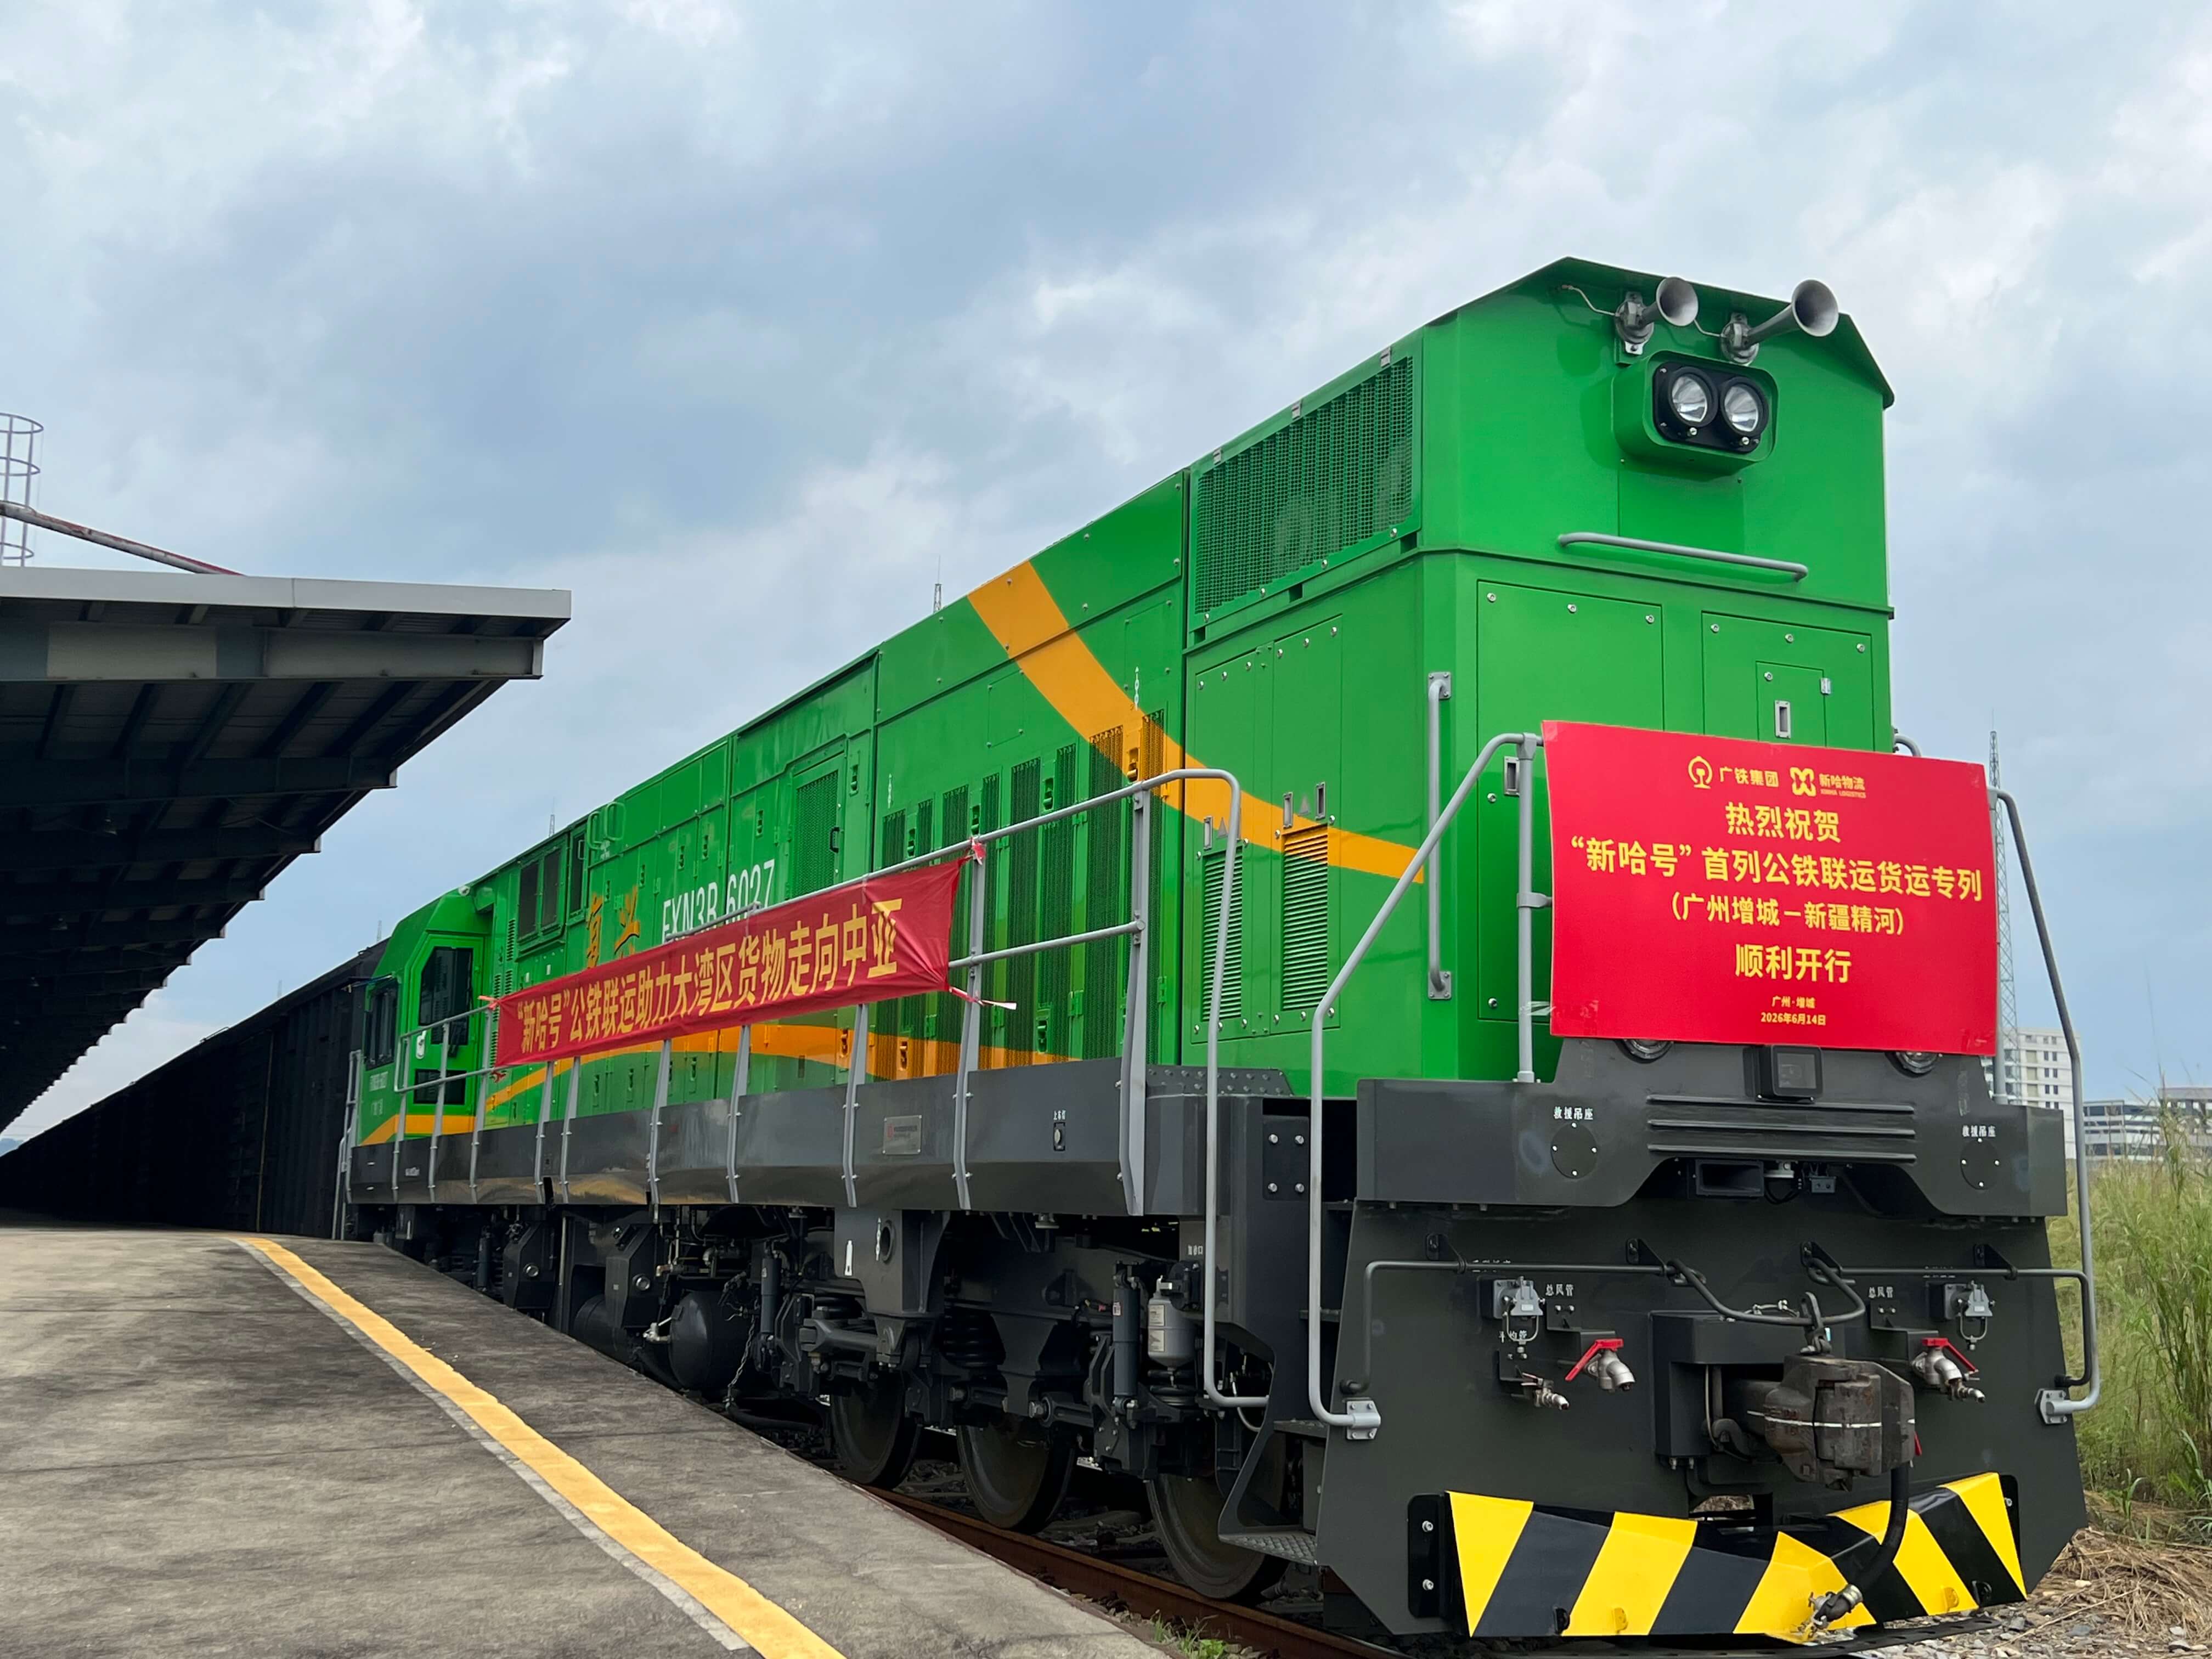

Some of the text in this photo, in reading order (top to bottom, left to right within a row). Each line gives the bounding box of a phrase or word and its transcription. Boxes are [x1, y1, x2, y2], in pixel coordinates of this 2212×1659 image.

[1719, 766, 1779, 787] 广铁集团
[1819, 774, 1865, 790] 新哈物流
[1725, 802, 1841, 843] 热烈祝贺
[1735, 944, 1852, 984] 顺利开行
[1760, 1012, 1826, 1026] 2026年6月14日
[1553, 1105, 1594, 1120] 救援吊座
[1545, 1284, 1573, 1296] 总风管
